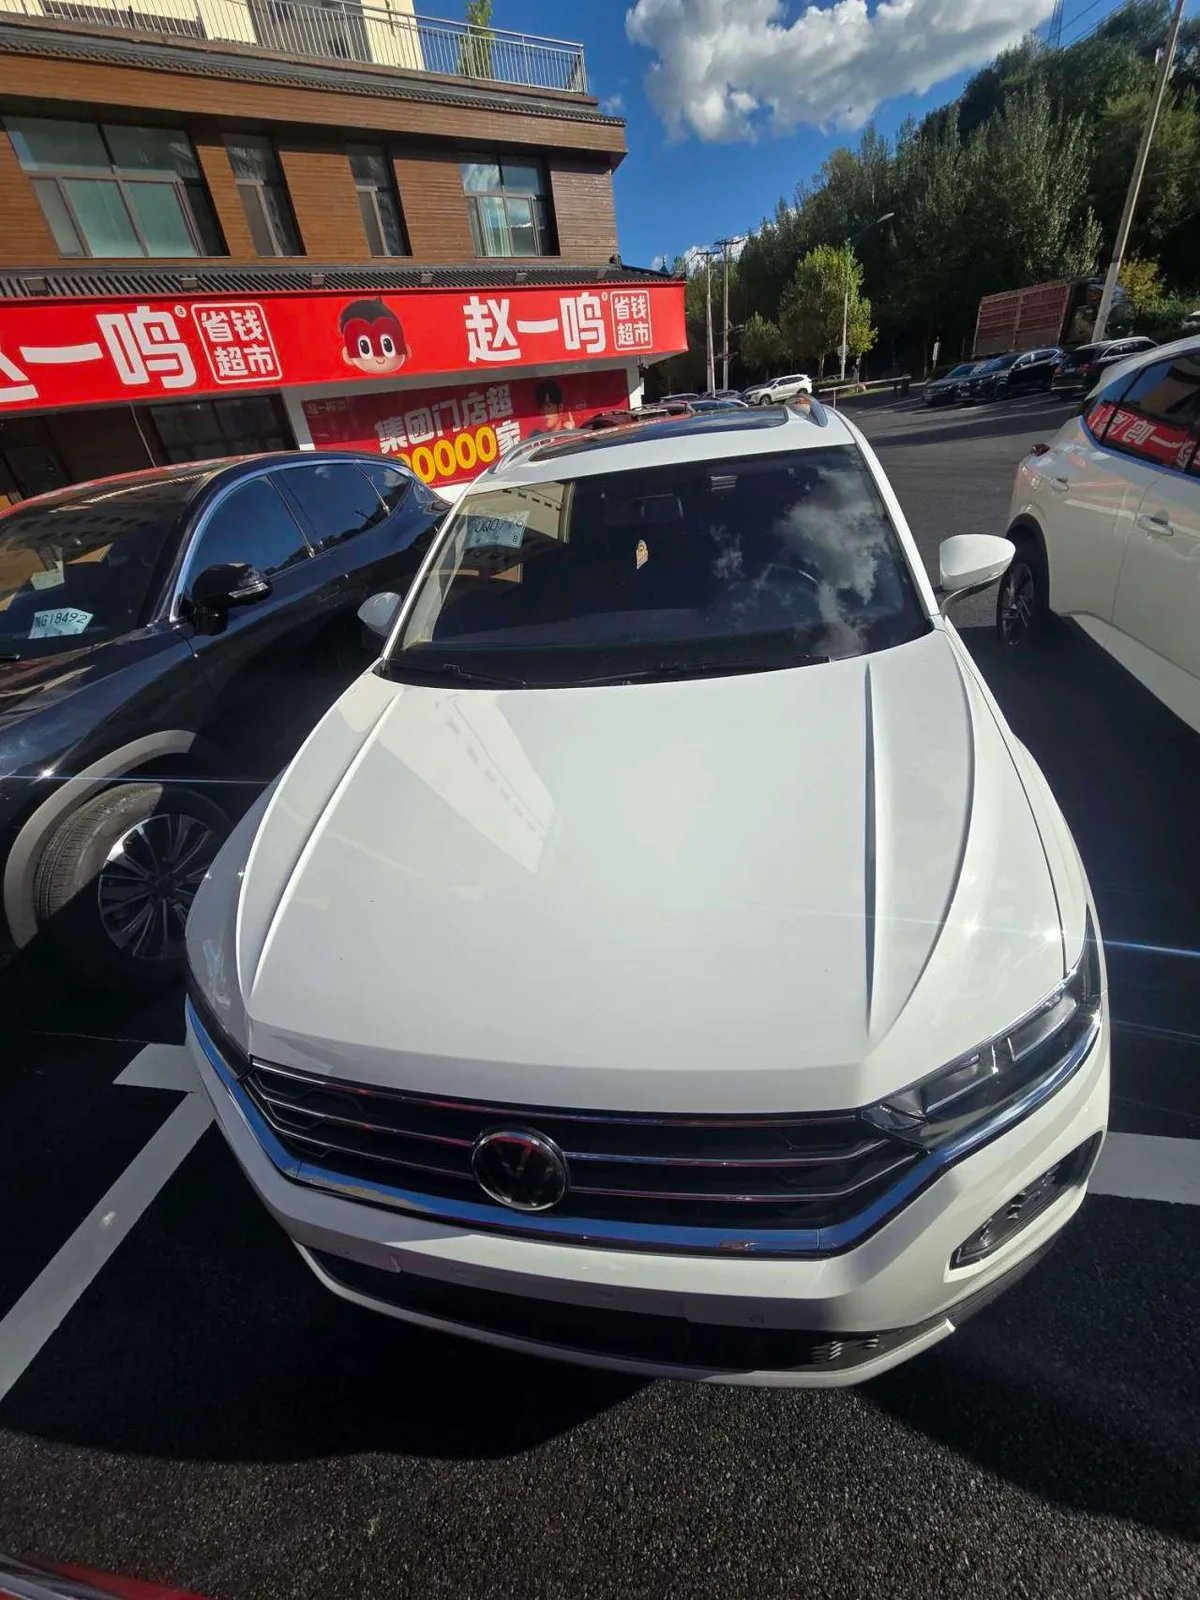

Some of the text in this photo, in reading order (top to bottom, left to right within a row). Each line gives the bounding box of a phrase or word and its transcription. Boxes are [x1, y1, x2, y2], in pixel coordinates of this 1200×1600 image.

[614, 295, 647, 320] 省钱
[201, 309, 264, 343] 省钱
[463, 292, 606, 363] 赵一鸣
[617, 321, 649, 346] 超市
[213, 343, 275, 377] 超市
[374, 383, 513, 454] 集团门店超
